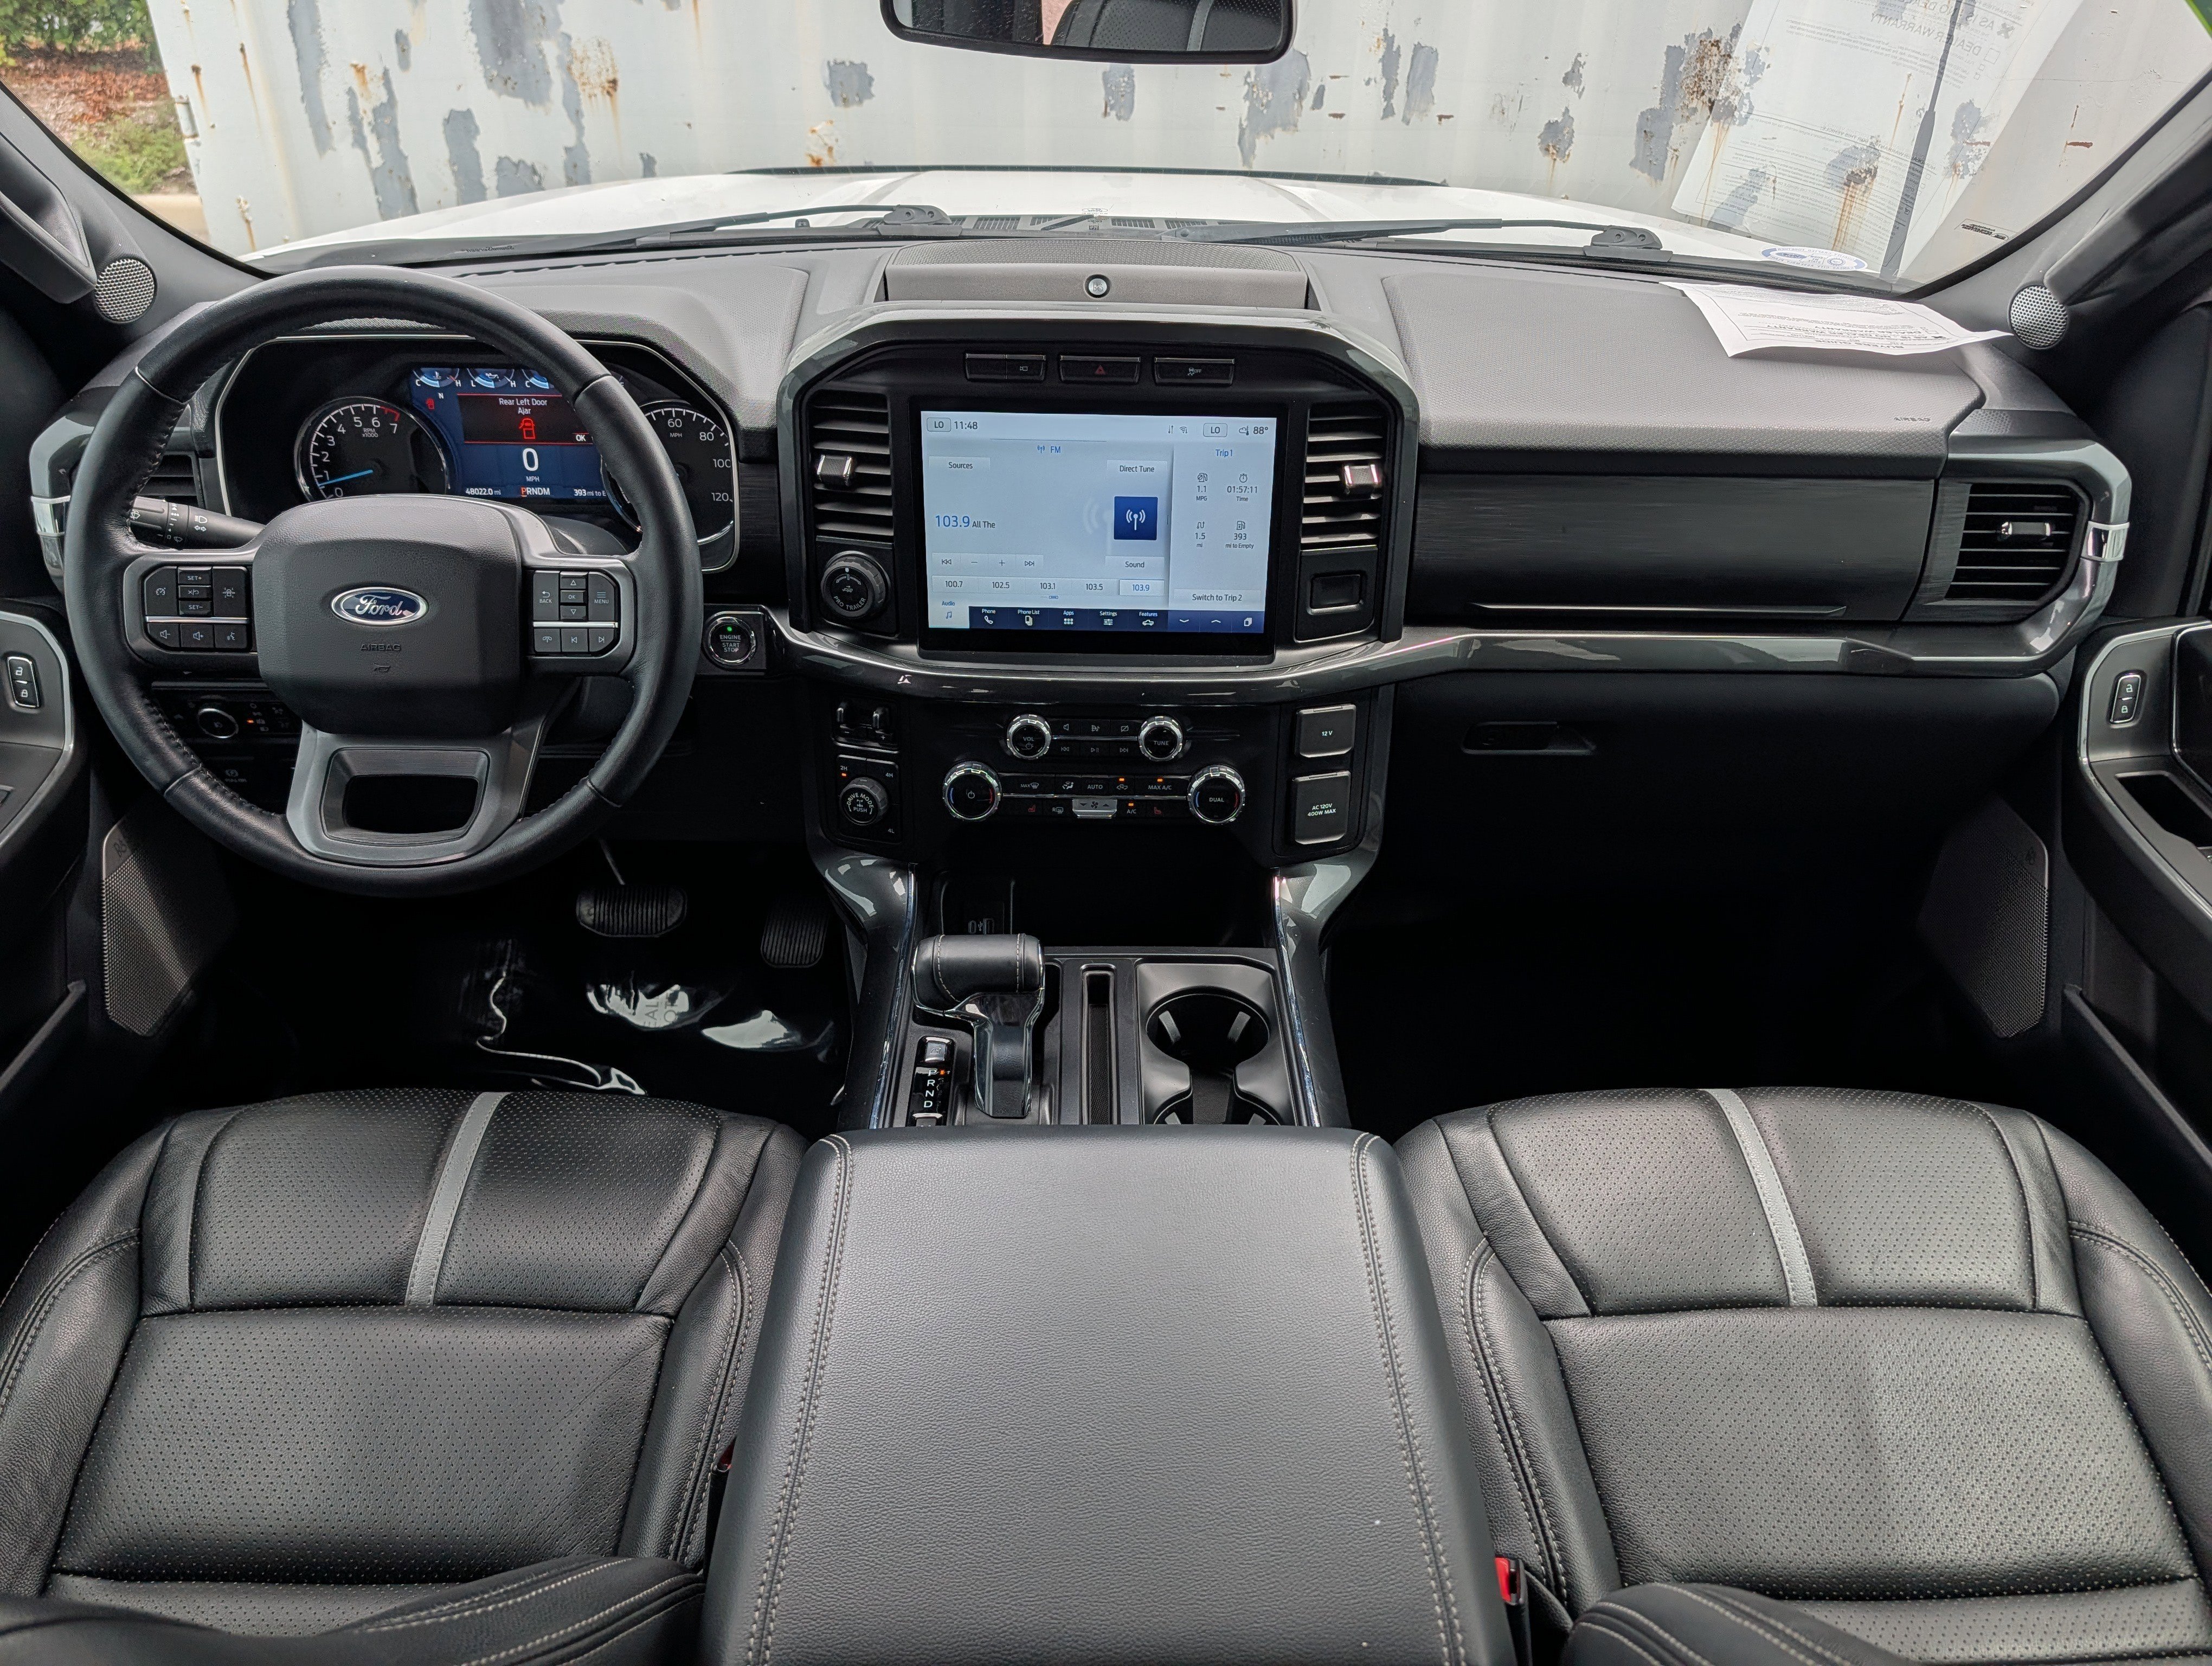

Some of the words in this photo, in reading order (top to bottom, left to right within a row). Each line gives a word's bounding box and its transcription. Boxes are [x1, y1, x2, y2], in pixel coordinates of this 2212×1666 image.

[525, 380, 530, 388] C
[353, 416, 362, 427] 5
[371, 417, 381, 427] 6
[667, 418, 682, 427] 60
[934, 421, 944, 429] LO
[954, 421, 978, 430] 11:48
[338, 424, 346, 434] 4
[389, 423, 398, 433] 7
[1210, 426, 1220, 434] LO
[1253, 426, 1269, 435] 88°
[327, 435, 336, 446] 3
[699, 432, 714, 441] 80
[321, 452, 330, 462] 2
[522, 448, 539, 472] 0
[713, 459, 731, 468] 100
[948, 462, 973, 470] Sources
[1119, 465, 1137, 473] Direct
[324, 470, 330, 480] 1
[335, 488, 343, 497] 0
[1226, 486, 1258, 494] 01:57:11
[711, 492, 729, 502] 120
[935, 515, 970, 528] 103.9
[972, 520, 981, 528] All
[982, 521, 995, 529] The
[945, 580, 963, 588] 100.7
[992, 581, 1010, 589] 102.5
[1040, 582, 1056, 590] 103.1
[1085, 582, 1103, 591] 103.5
[1132, 584, 1150, 592] 103.9
[833, 595, 844, 607] PRO
[846, 597, 866, 610] TRAILER
[1192, 593, 1213, 601] Switch
[1222, 594, 1235, 603] Trip
[355, 594, 403, 616] Ford
[846, 792, 859, 805] DRIVE
[860, 793, 874, 809] MODE
[925, 1090, 935, 1098] N
